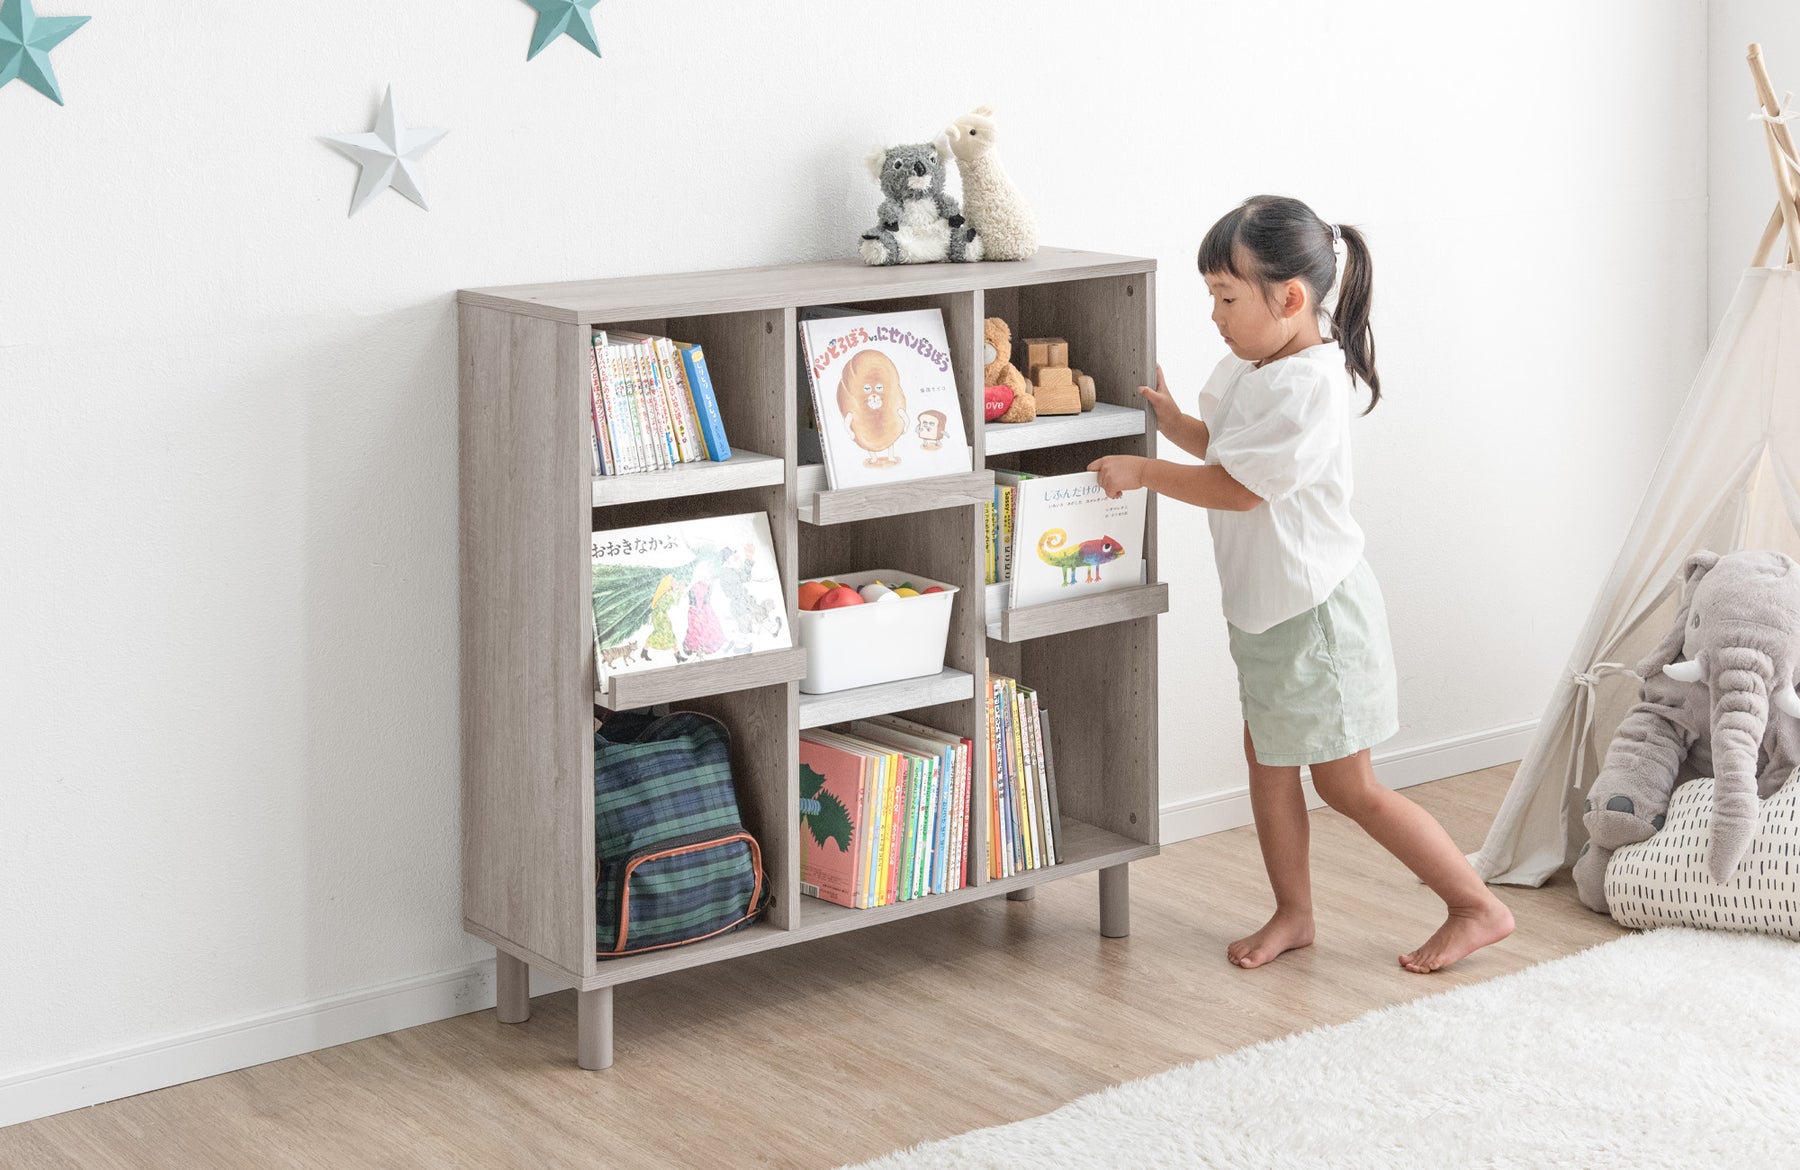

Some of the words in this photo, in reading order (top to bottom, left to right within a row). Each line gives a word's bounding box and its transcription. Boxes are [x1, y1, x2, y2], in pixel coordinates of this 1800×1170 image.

[985, 401, 1004, 410] ove
[592, 535, 679, 558] おおきなかぶ
